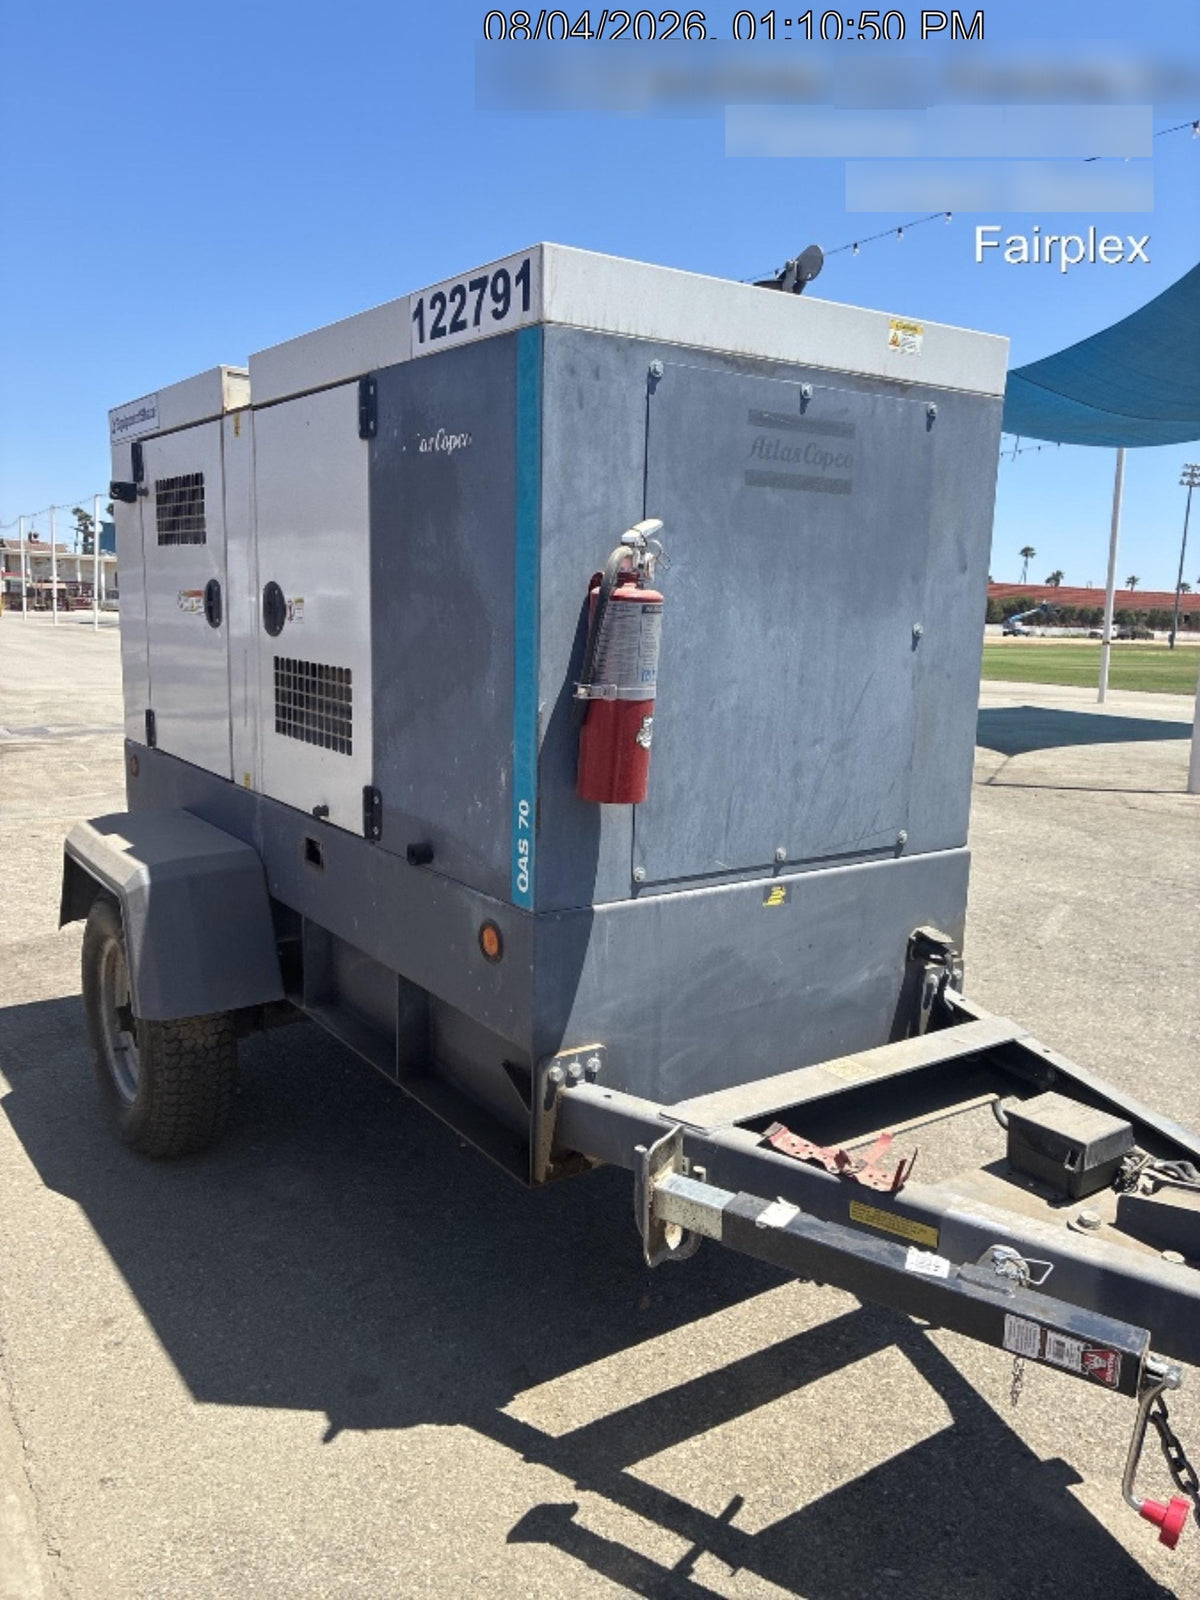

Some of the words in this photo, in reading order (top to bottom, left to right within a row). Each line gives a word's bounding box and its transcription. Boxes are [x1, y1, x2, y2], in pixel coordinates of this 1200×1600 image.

[412, 257, 531, 344] 122791
[518, 799, 530, 830] 70
[517, 838, 529, 893] QAS
